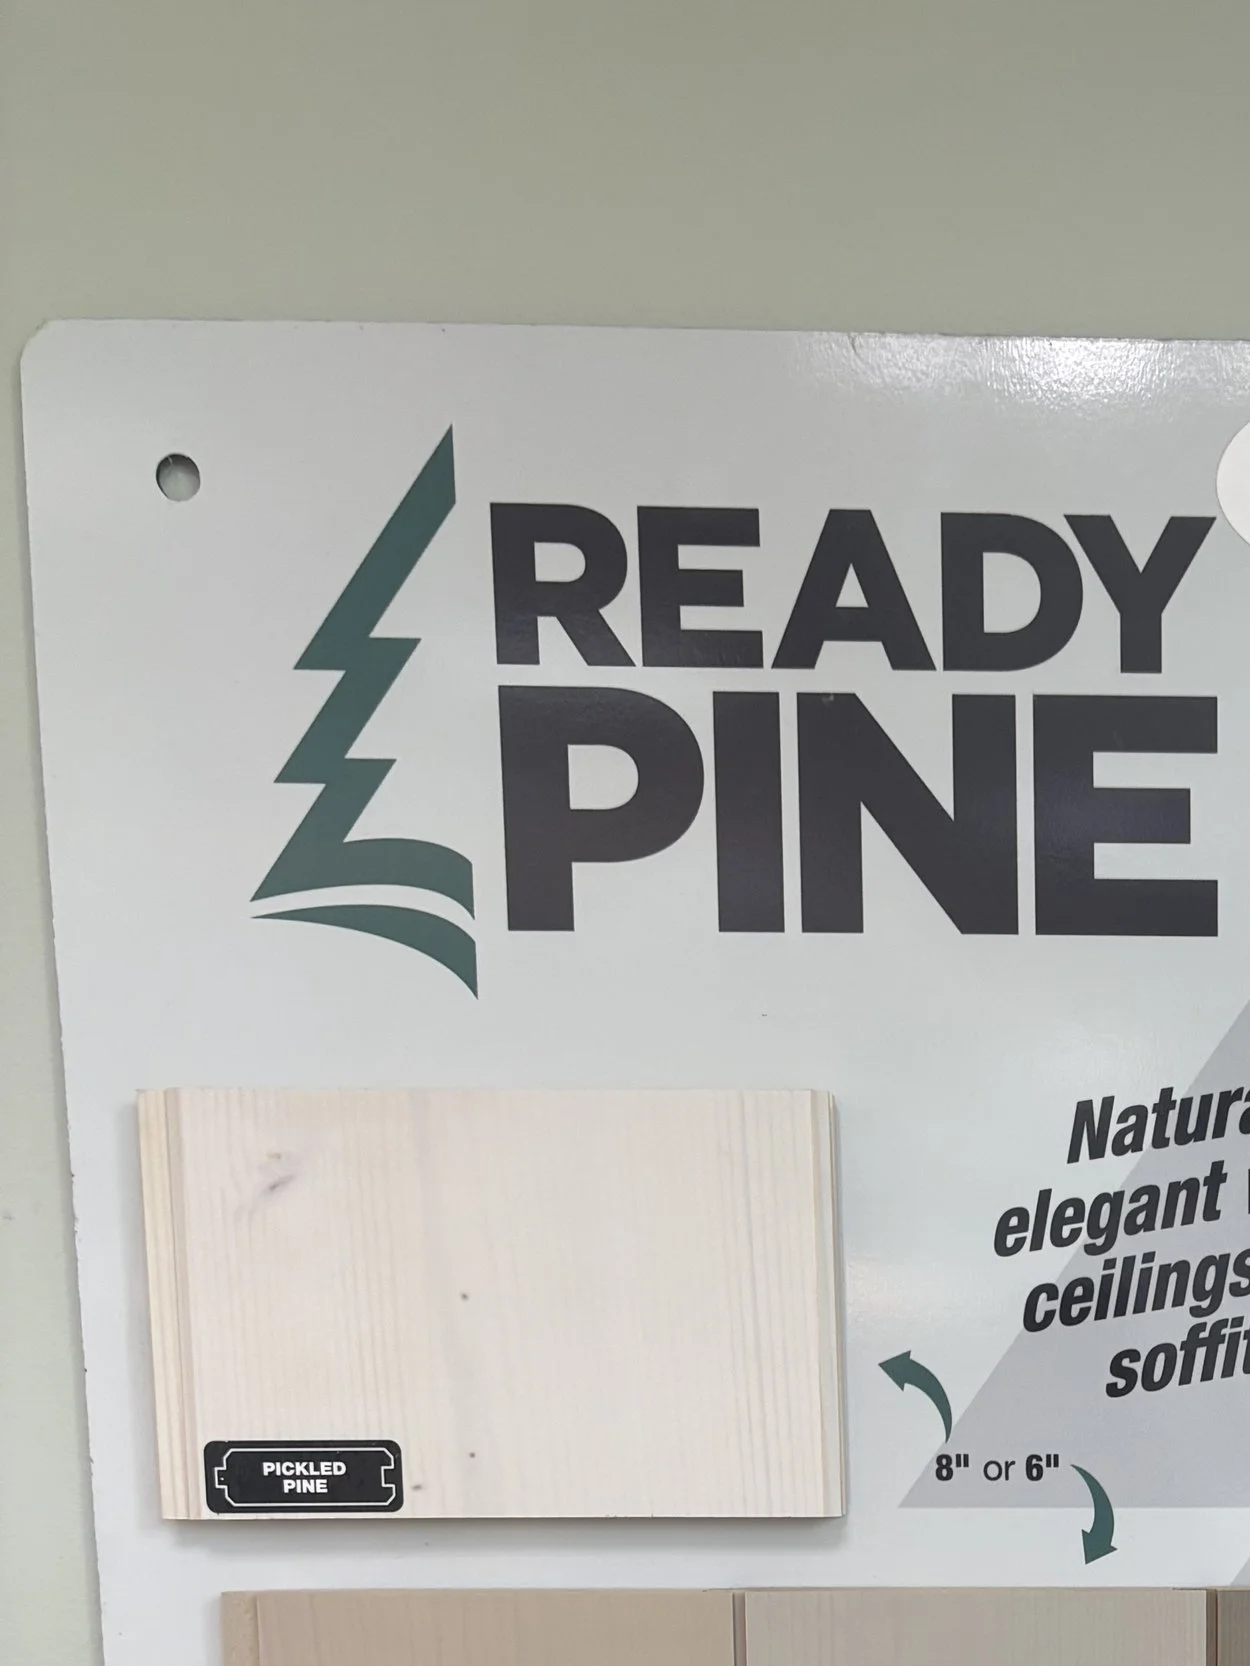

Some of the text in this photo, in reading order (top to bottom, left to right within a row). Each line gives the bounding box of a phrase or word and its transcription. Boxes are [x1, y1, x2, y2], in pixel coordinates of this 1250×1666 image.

[490, 502, 1217, 673] READY
[498, 685, 1218, 937] PINE
[993, 1160, 1228, 1257] elegant
[262, 1461, 347, 1476] PICKLED
[283, 1479, 328, 1494] PINE
[935, 1453, 1060, 1482] 8" or 6"
